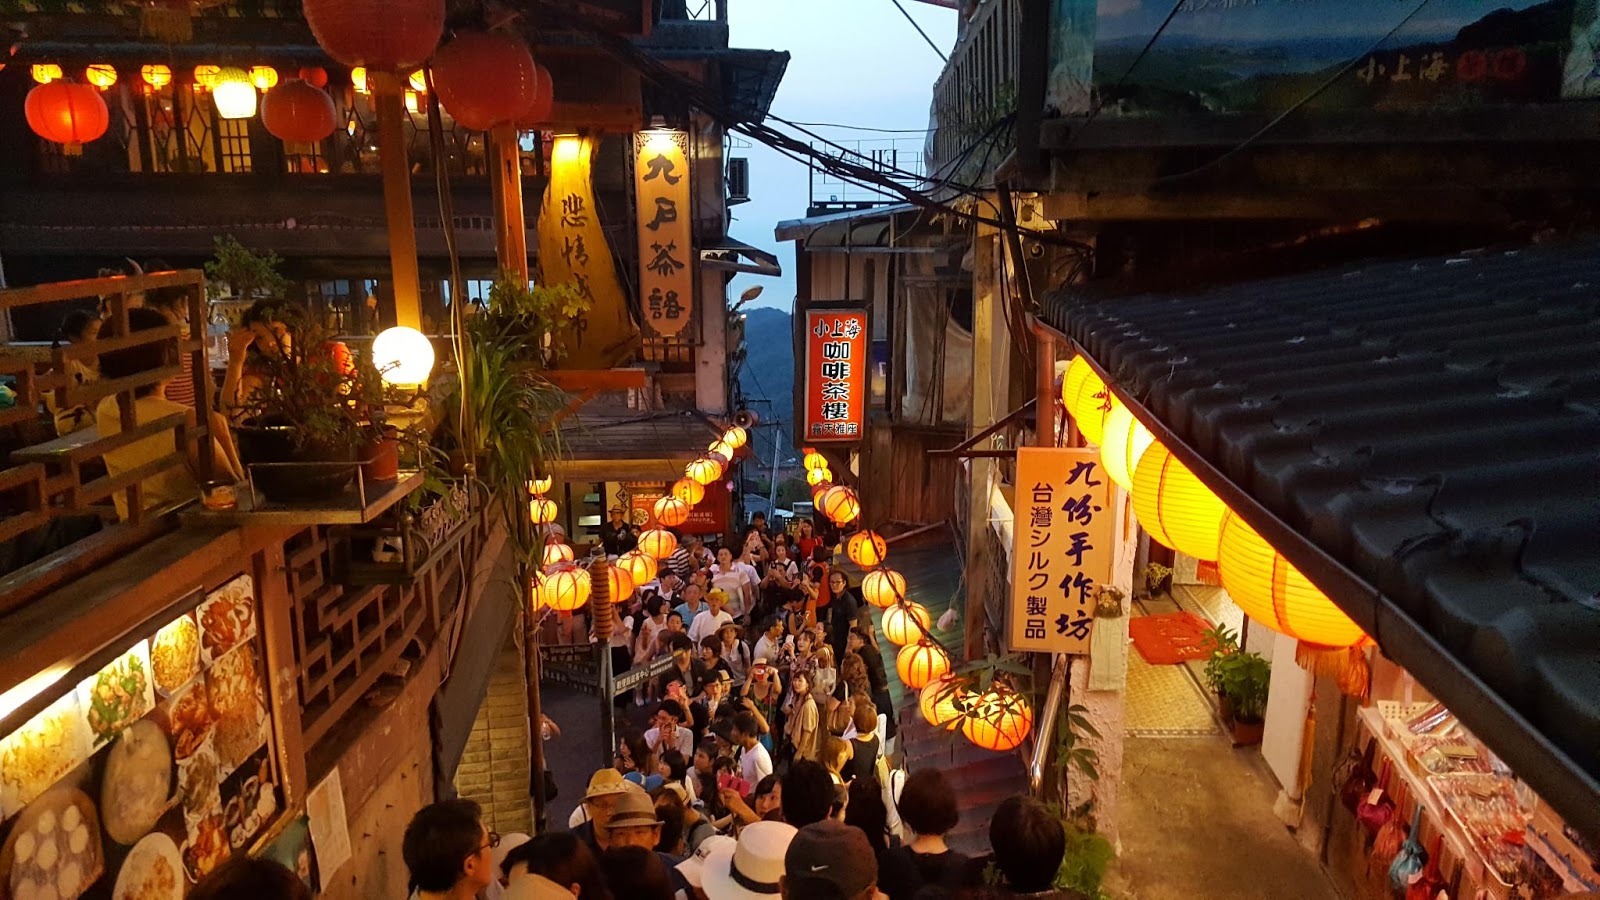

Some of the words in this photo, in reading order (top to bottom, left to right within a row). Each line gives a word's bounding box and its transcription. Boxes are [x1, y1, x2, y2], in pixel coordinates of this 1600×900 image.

[1357, 52, 1449, 86] 小上海
[814, 319, 861, 338] 小上海
[822, 342, 851, 420] 咖啡茶樓
[811, 422, 858, 435] 露天雅座
[1025, 482, 1054, 639] 台灣シルク製品
[1055, 461, 1102, 641] 九份手作坊
